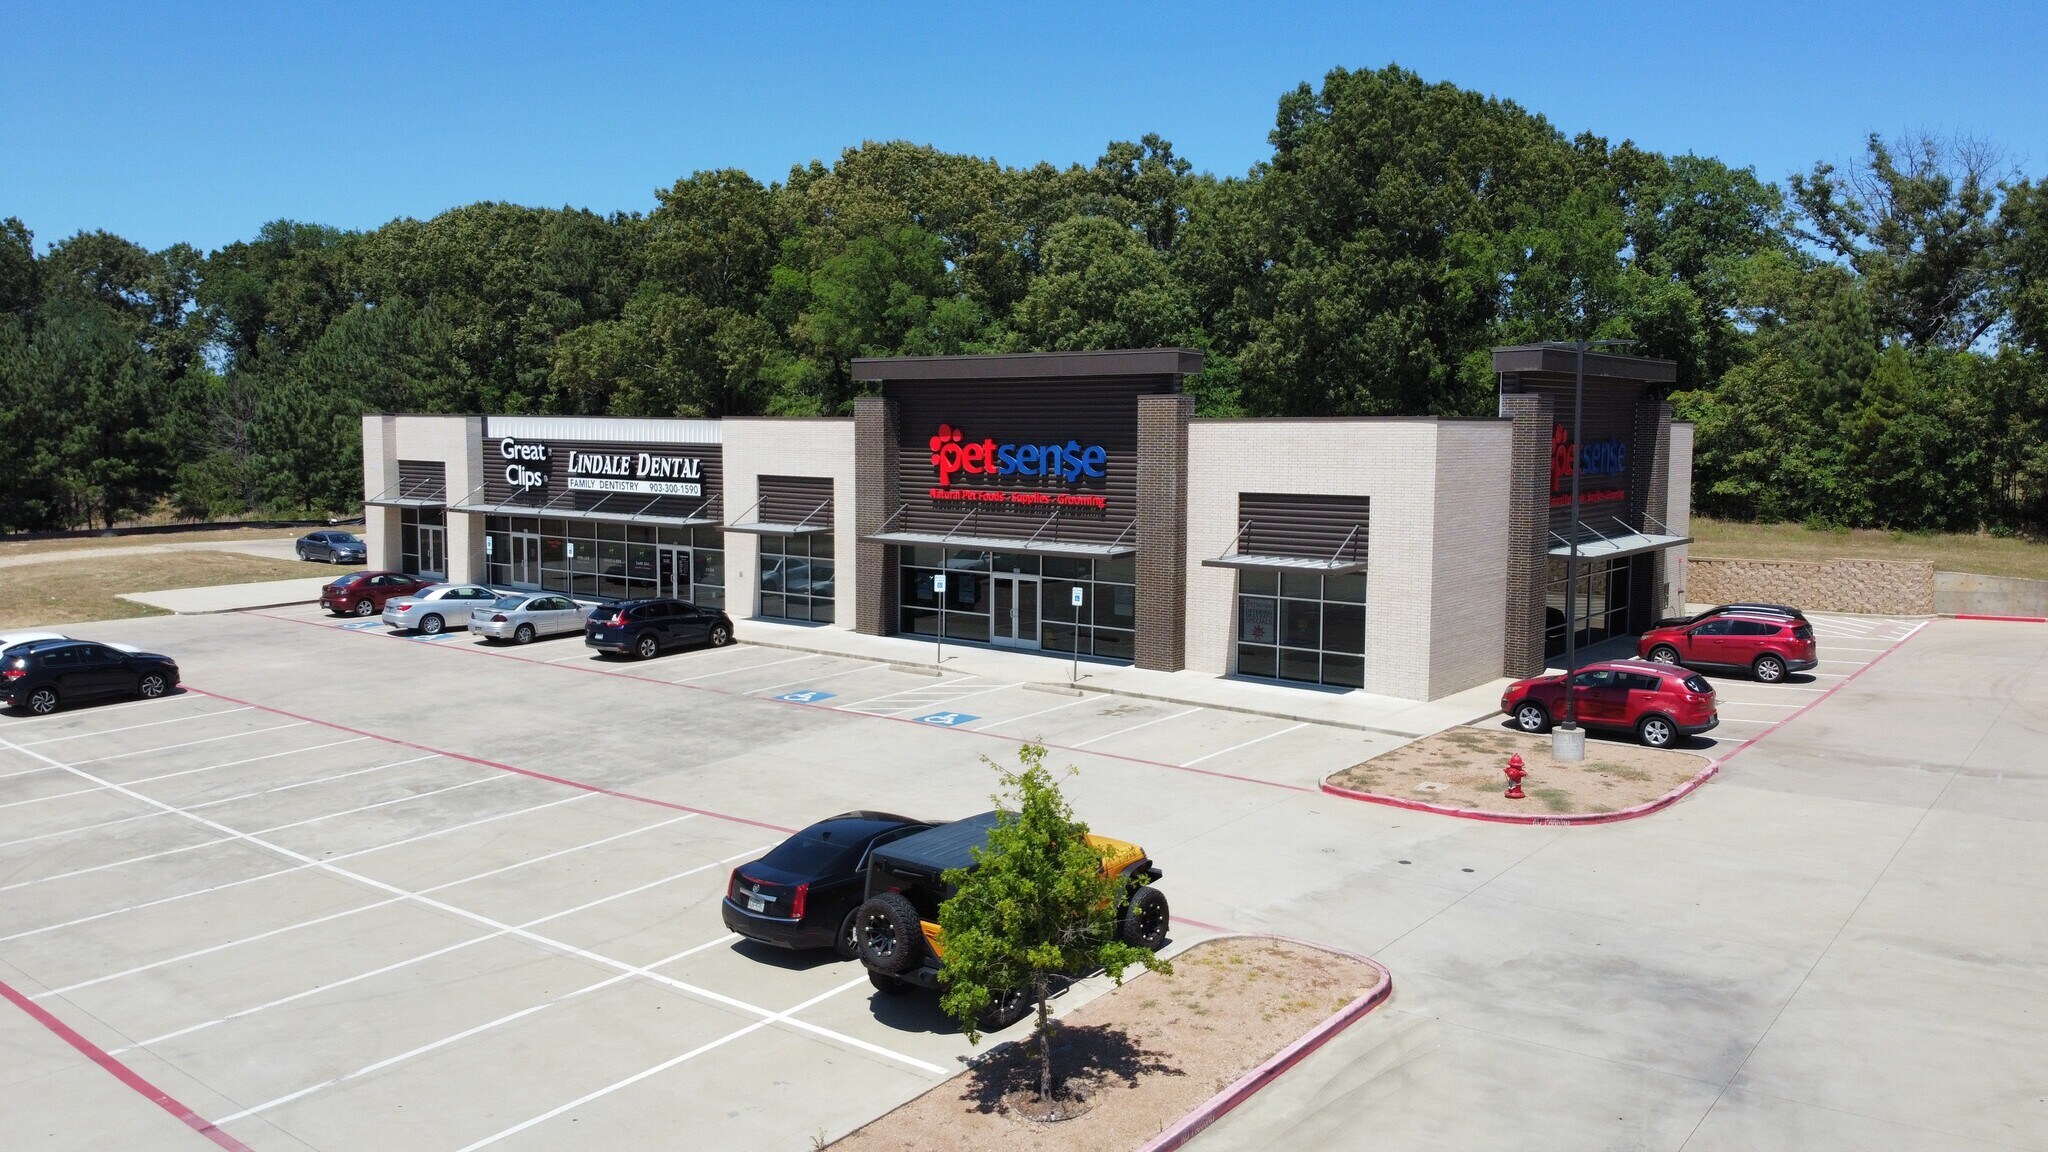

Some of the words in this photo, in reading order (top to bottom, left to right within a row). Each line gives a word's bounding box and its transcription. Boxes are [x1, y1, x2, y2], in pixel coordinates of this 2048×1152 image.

[501, 437, 546, 461] Great
[568, 451, 631, 476] LINDALE
[636, 453, 701, 479] DENTAL
[505, 464, 543, 491] Clips
[570, 479, 595, 489] FAMILY
[599, 481, 639, 492] DENTISTRY
[649, 483, 699, 495] 903-300-1590
[930, 488, 961, 500] Natural
[962, 490, 977, 501] Pet
[978, 491, 1005, 502] Foods
[1011, 492, 1049, 505] Supplies
[1057, 493, 1107, 508] Grooming
